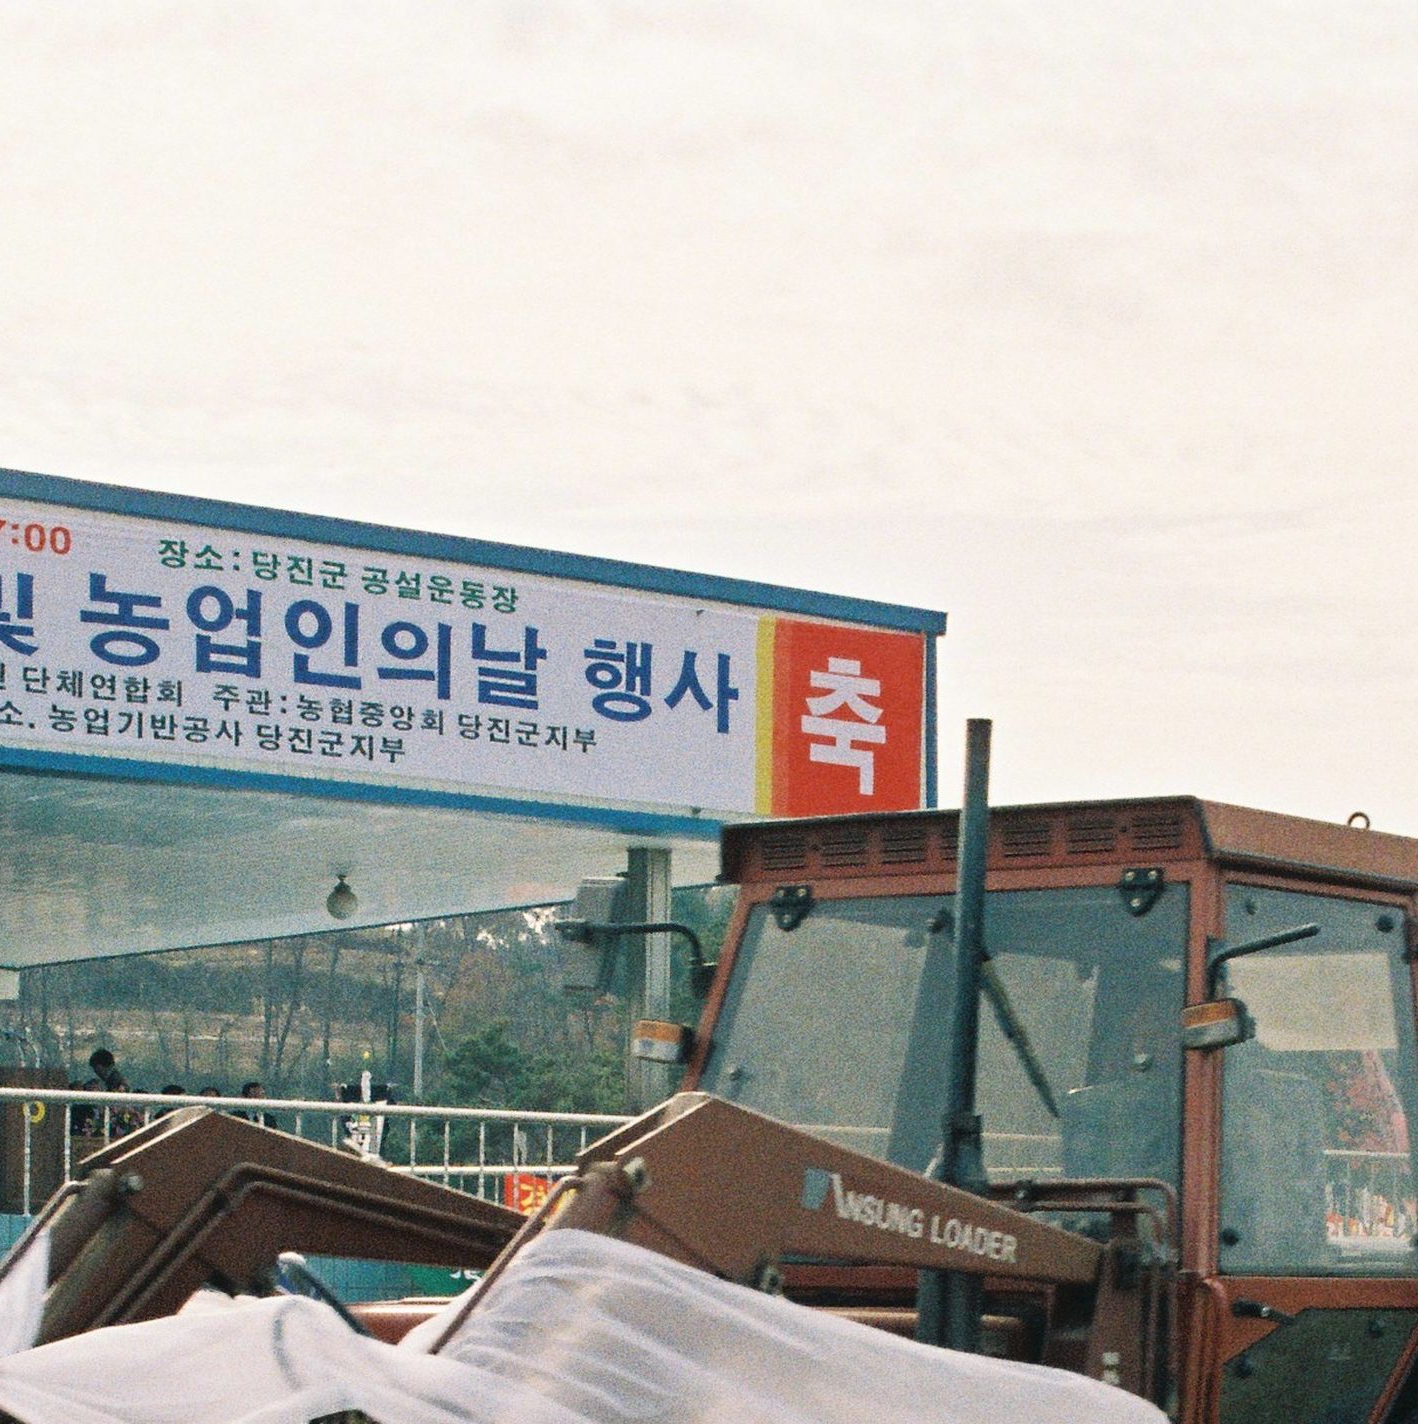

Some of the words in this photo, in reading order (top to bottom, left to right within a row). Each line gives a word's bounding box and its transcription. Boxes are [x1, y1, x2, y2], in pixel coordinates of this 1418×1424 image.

[252, 550, 348, 593] 당진군
[361, 565, 520, 615] 공설운동장
[22, 660, 184, 709] 단체연합회
[297, 690, 444, 738] 농협중앙회
[457, 711, 598, 754] 당진군지부
[583, 637, 741, 735] 행사
[801, 655, 887, 796] 축
[48, 703, 244, 750] 농업기반공사
[255, 721, 407, 765] 당진군지부
[931, 1214, 1018, 1263] LOADER
